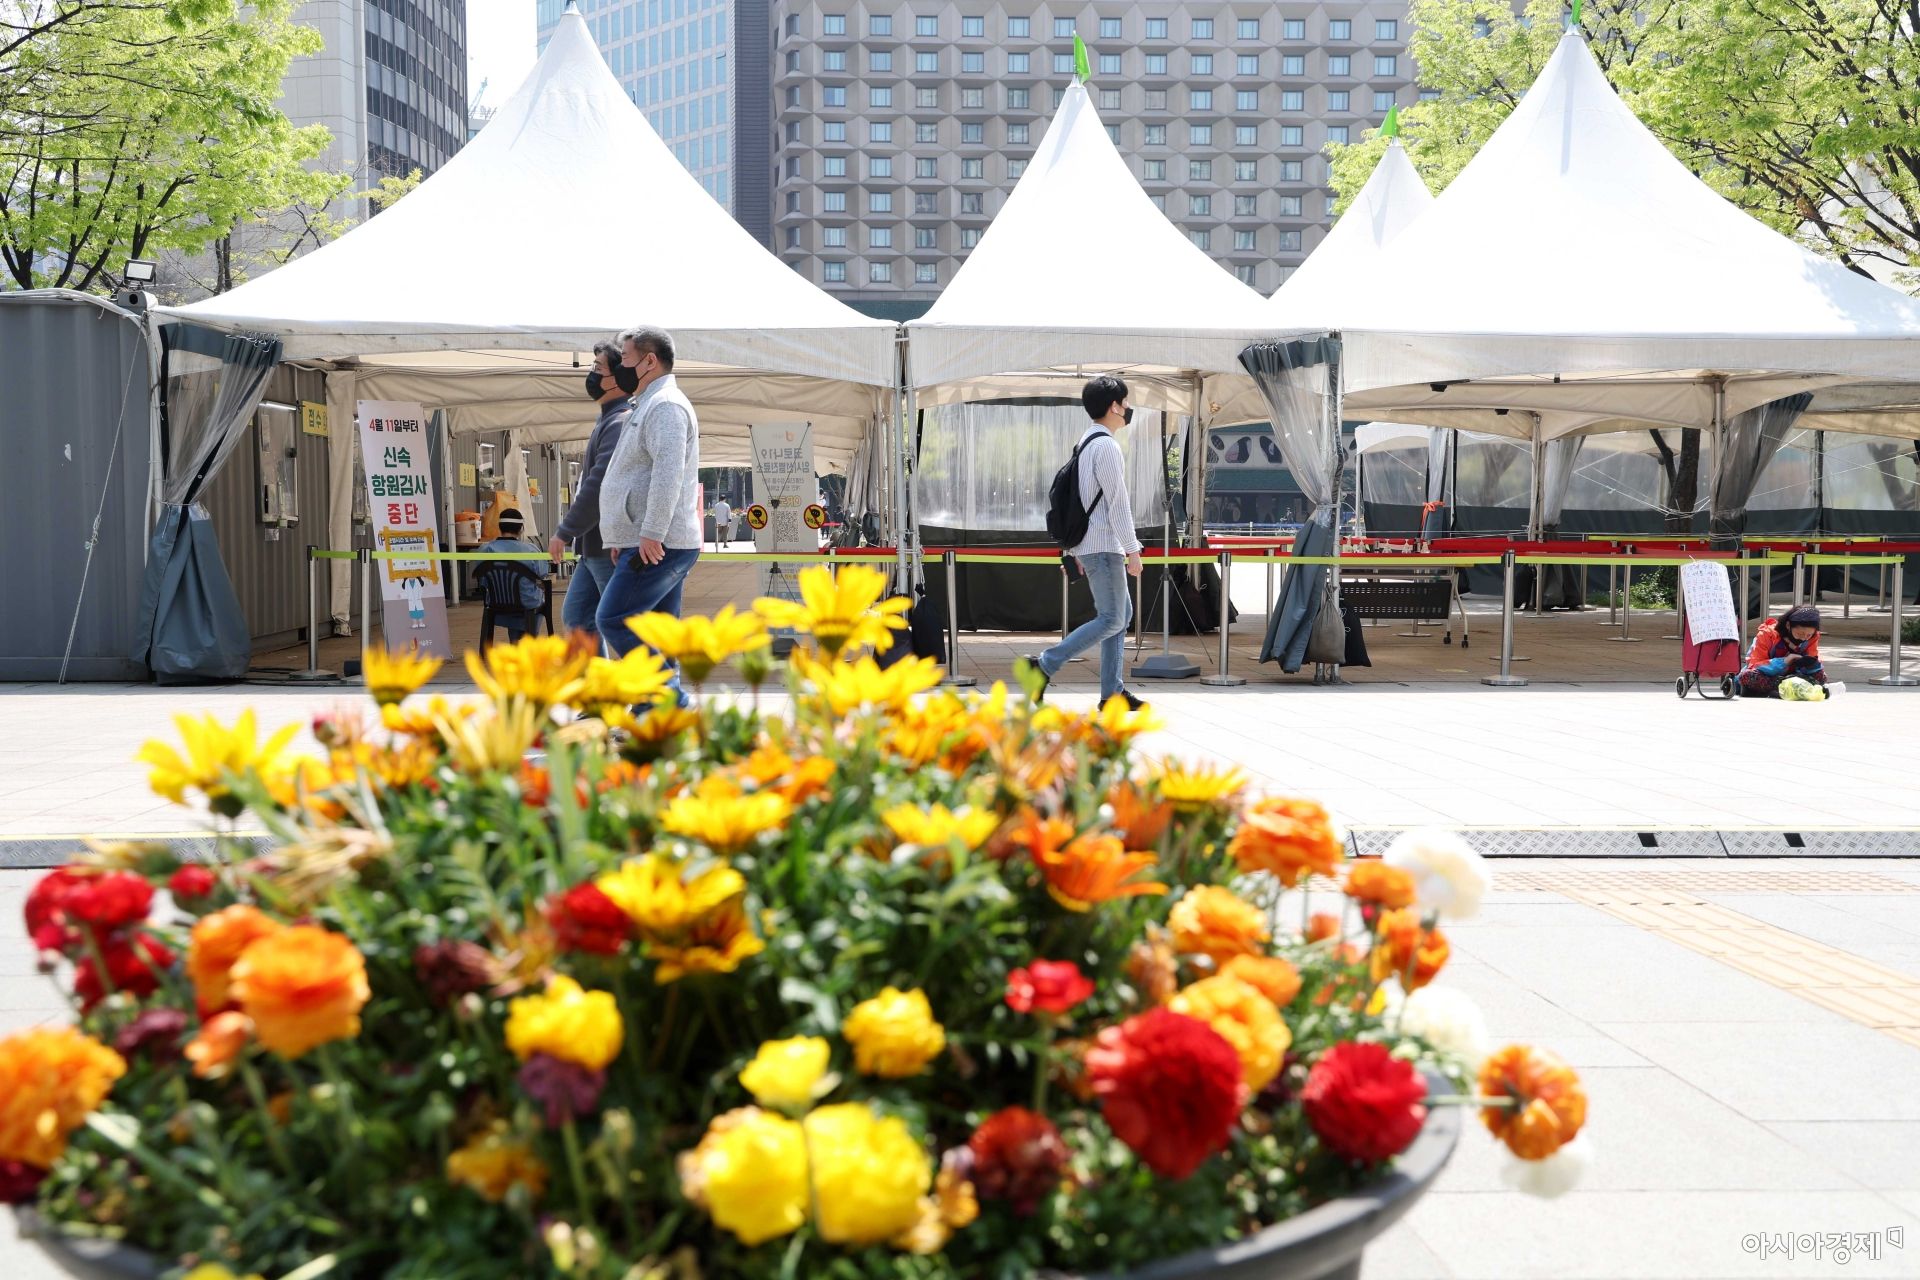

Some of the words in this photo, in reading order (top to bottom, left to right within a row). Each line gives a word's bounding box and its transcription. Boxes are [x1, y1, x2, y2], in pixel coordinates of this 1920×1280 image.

[369, 418, 384, 432] 4월
[385, 419, 419, 433] 11일부터
[384, 446, 411, 468] 신속
[371, 473, 427, 497] 항원검사
[387, 503, 418, 525] 중단
